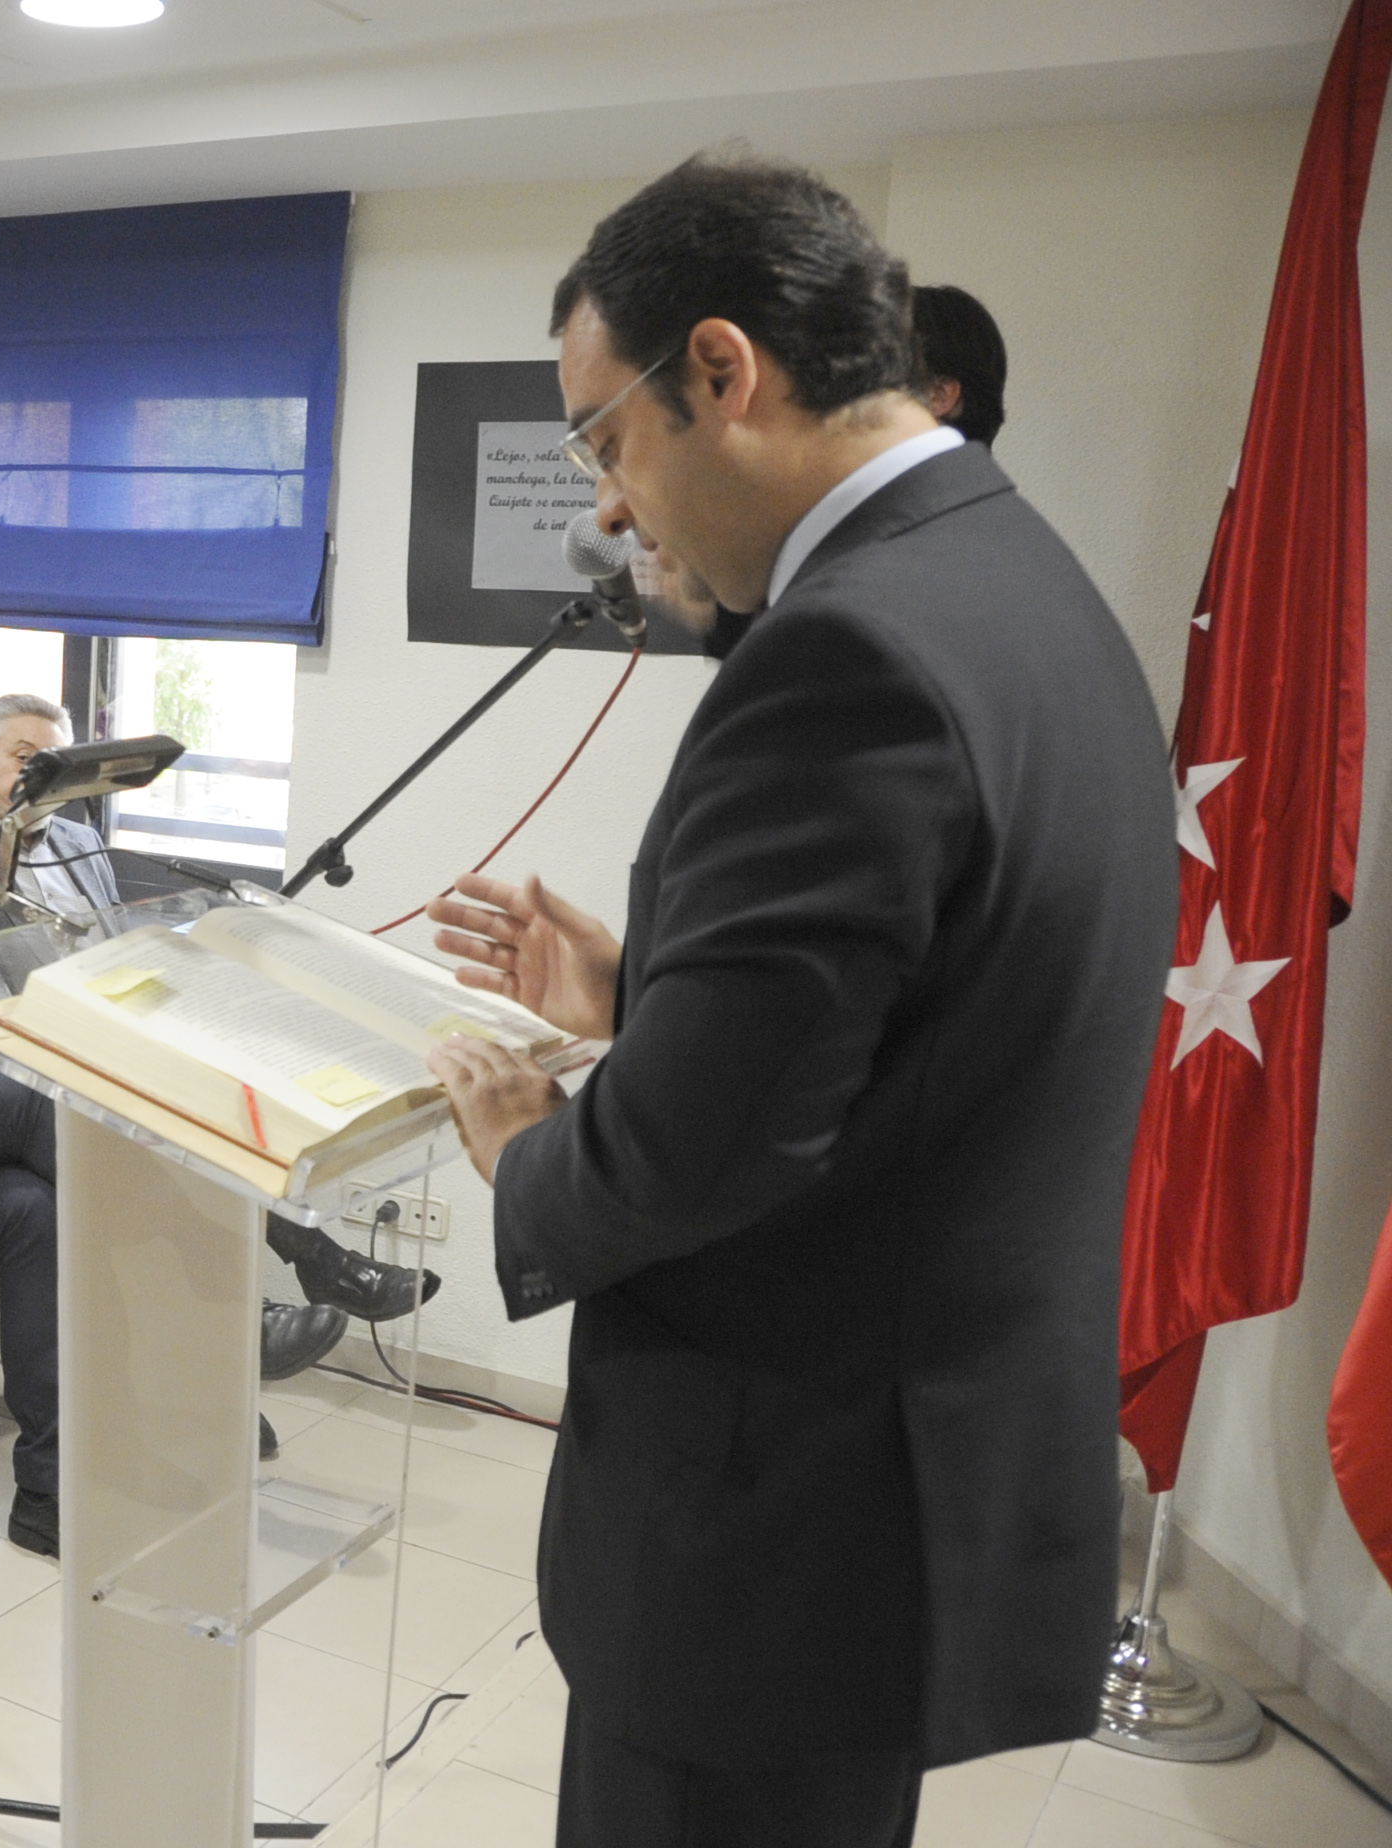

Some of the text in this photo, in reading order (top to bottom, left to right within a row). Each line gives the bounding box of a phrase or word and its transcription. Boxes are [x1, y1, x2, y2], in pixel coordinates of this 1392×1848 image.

[534, 449, 560, 461] sola
[486, 472, 596, 488] manchega, la larg
[489, 494, 532, 510] Quijote
[535, 499, 548, 507] se
[533, 518, 547, 530] de
